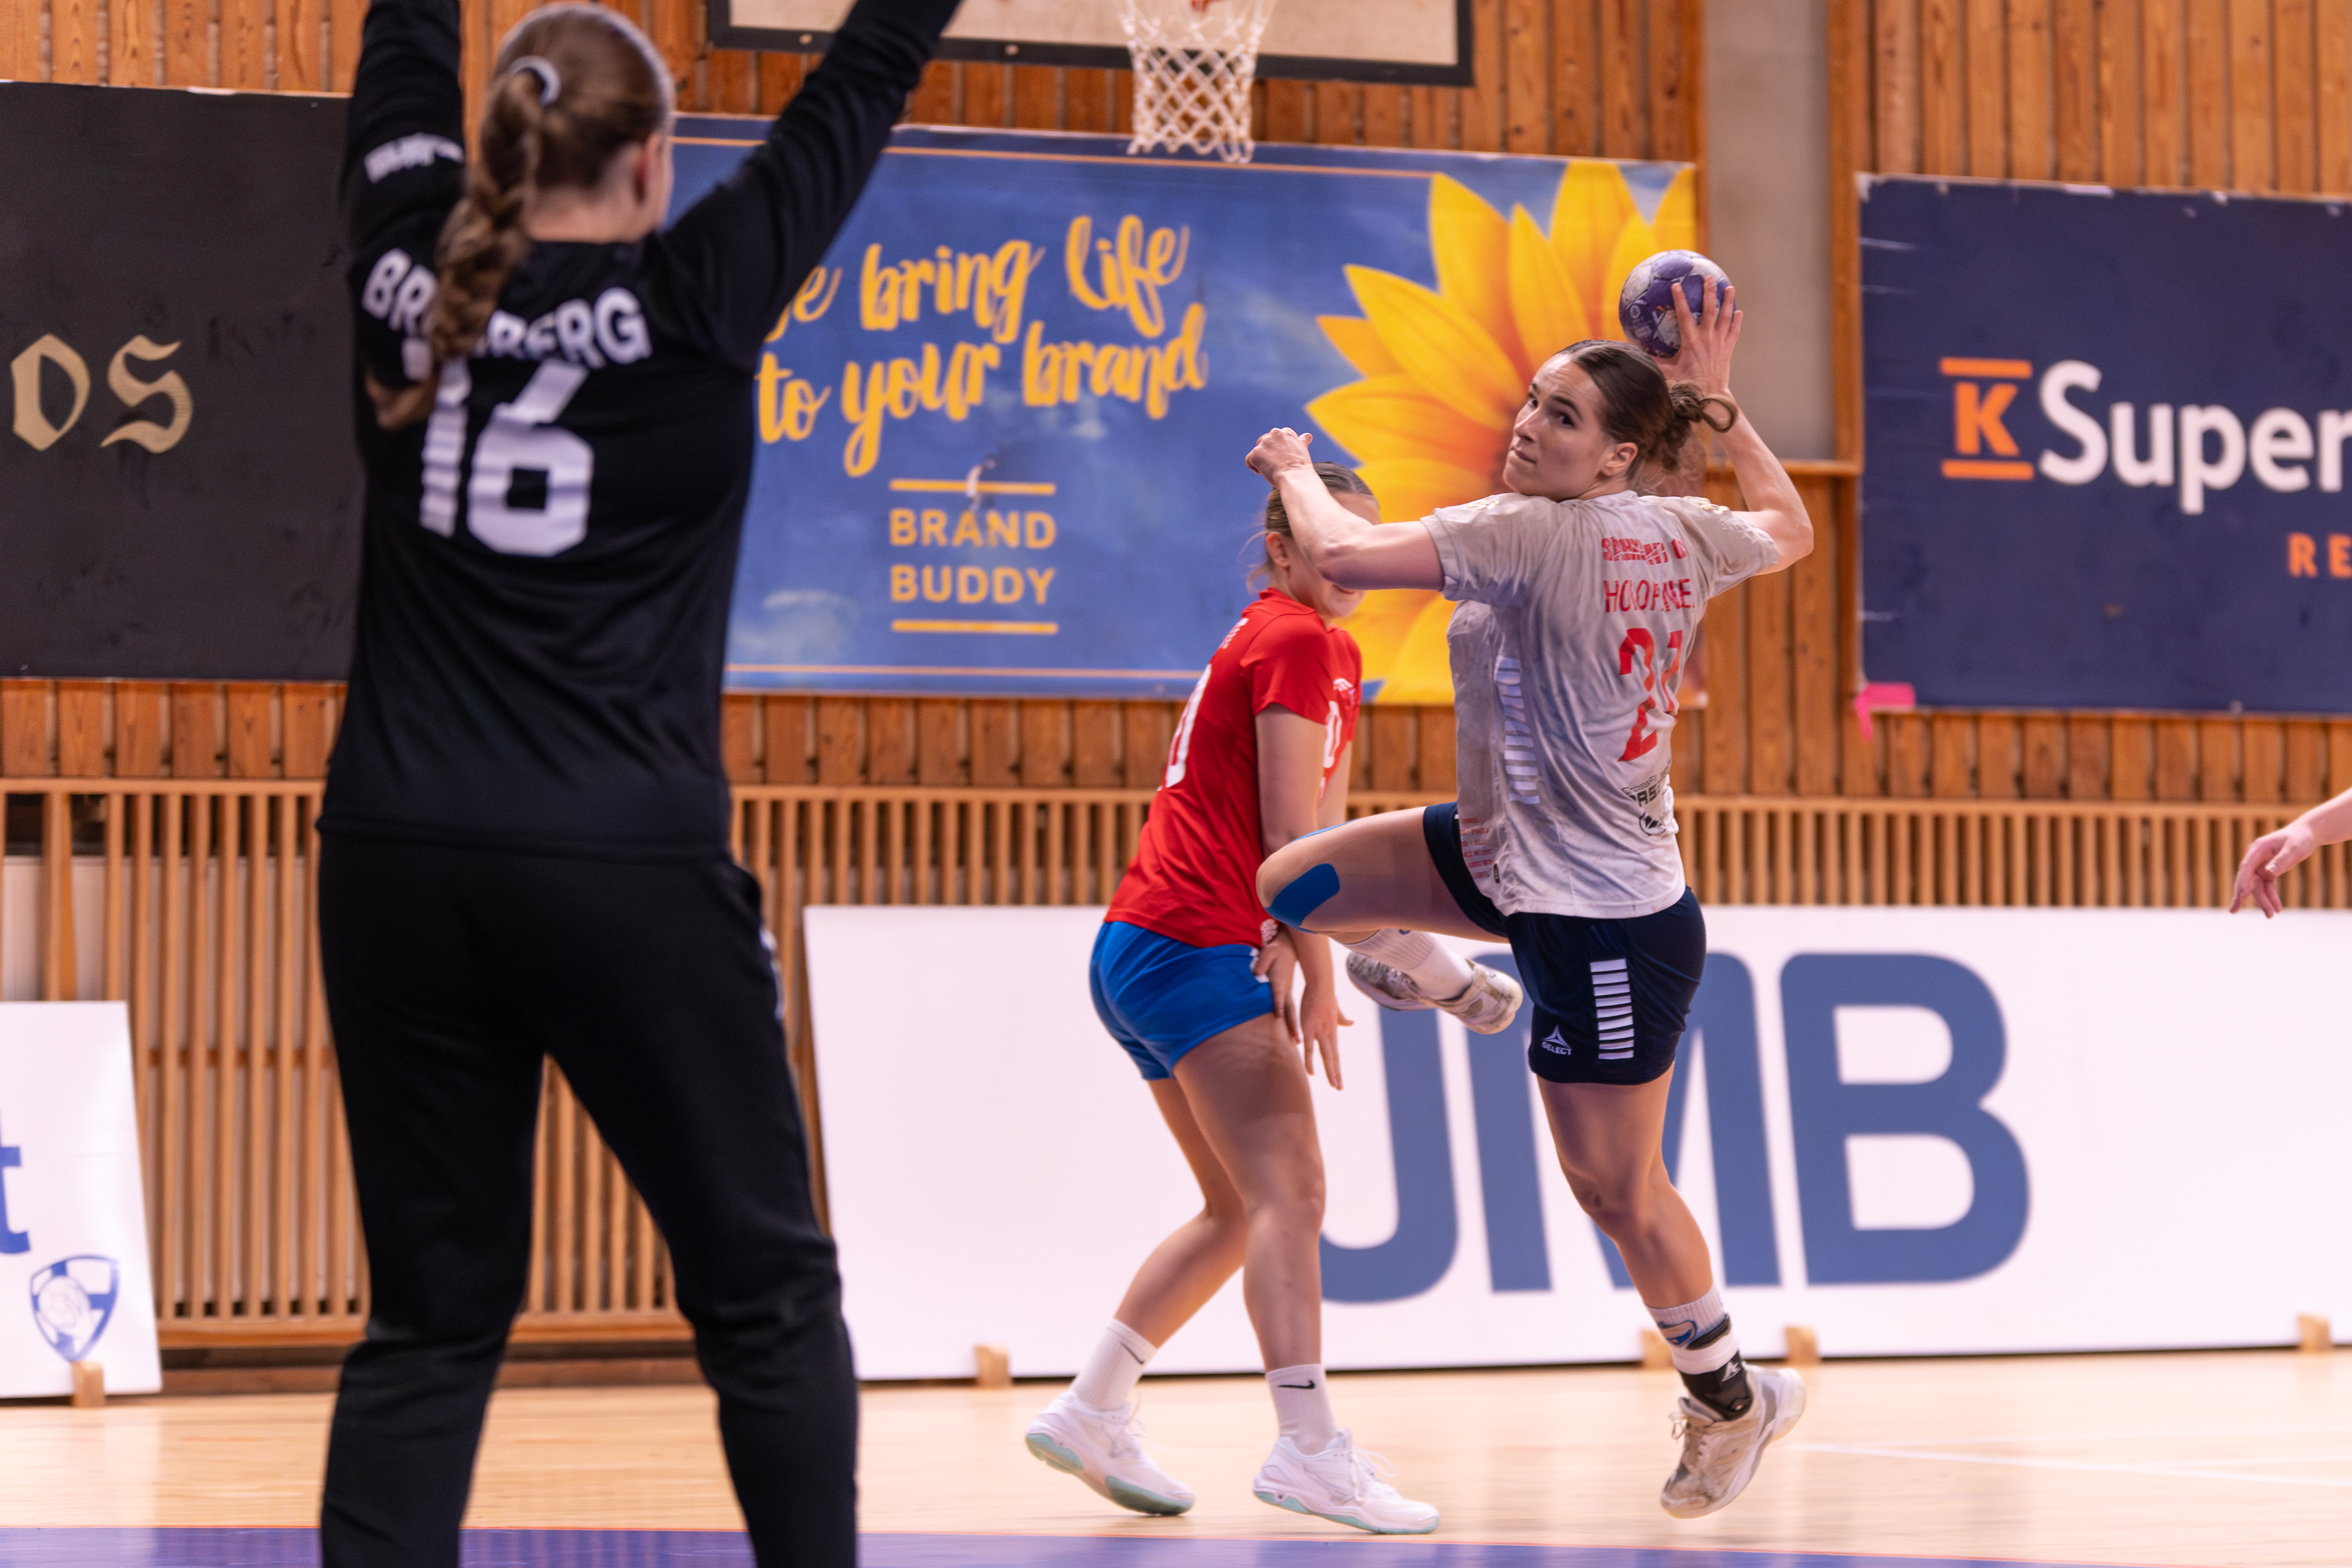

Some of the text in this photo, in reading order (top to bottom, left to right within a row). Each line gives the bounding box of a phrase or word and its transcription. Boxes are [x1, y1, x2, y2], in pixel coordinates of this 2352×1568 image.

[763, 215, 1190, 343] e bring life
[753, 302, 1209, 476] to your brand
[400, 337, 594, 558] 16
[889, 508, 1057, 549] BRAND
[890, 565, 1056, 605] BUDDY
[1541, 1041, 1572, 1056] SELECT
